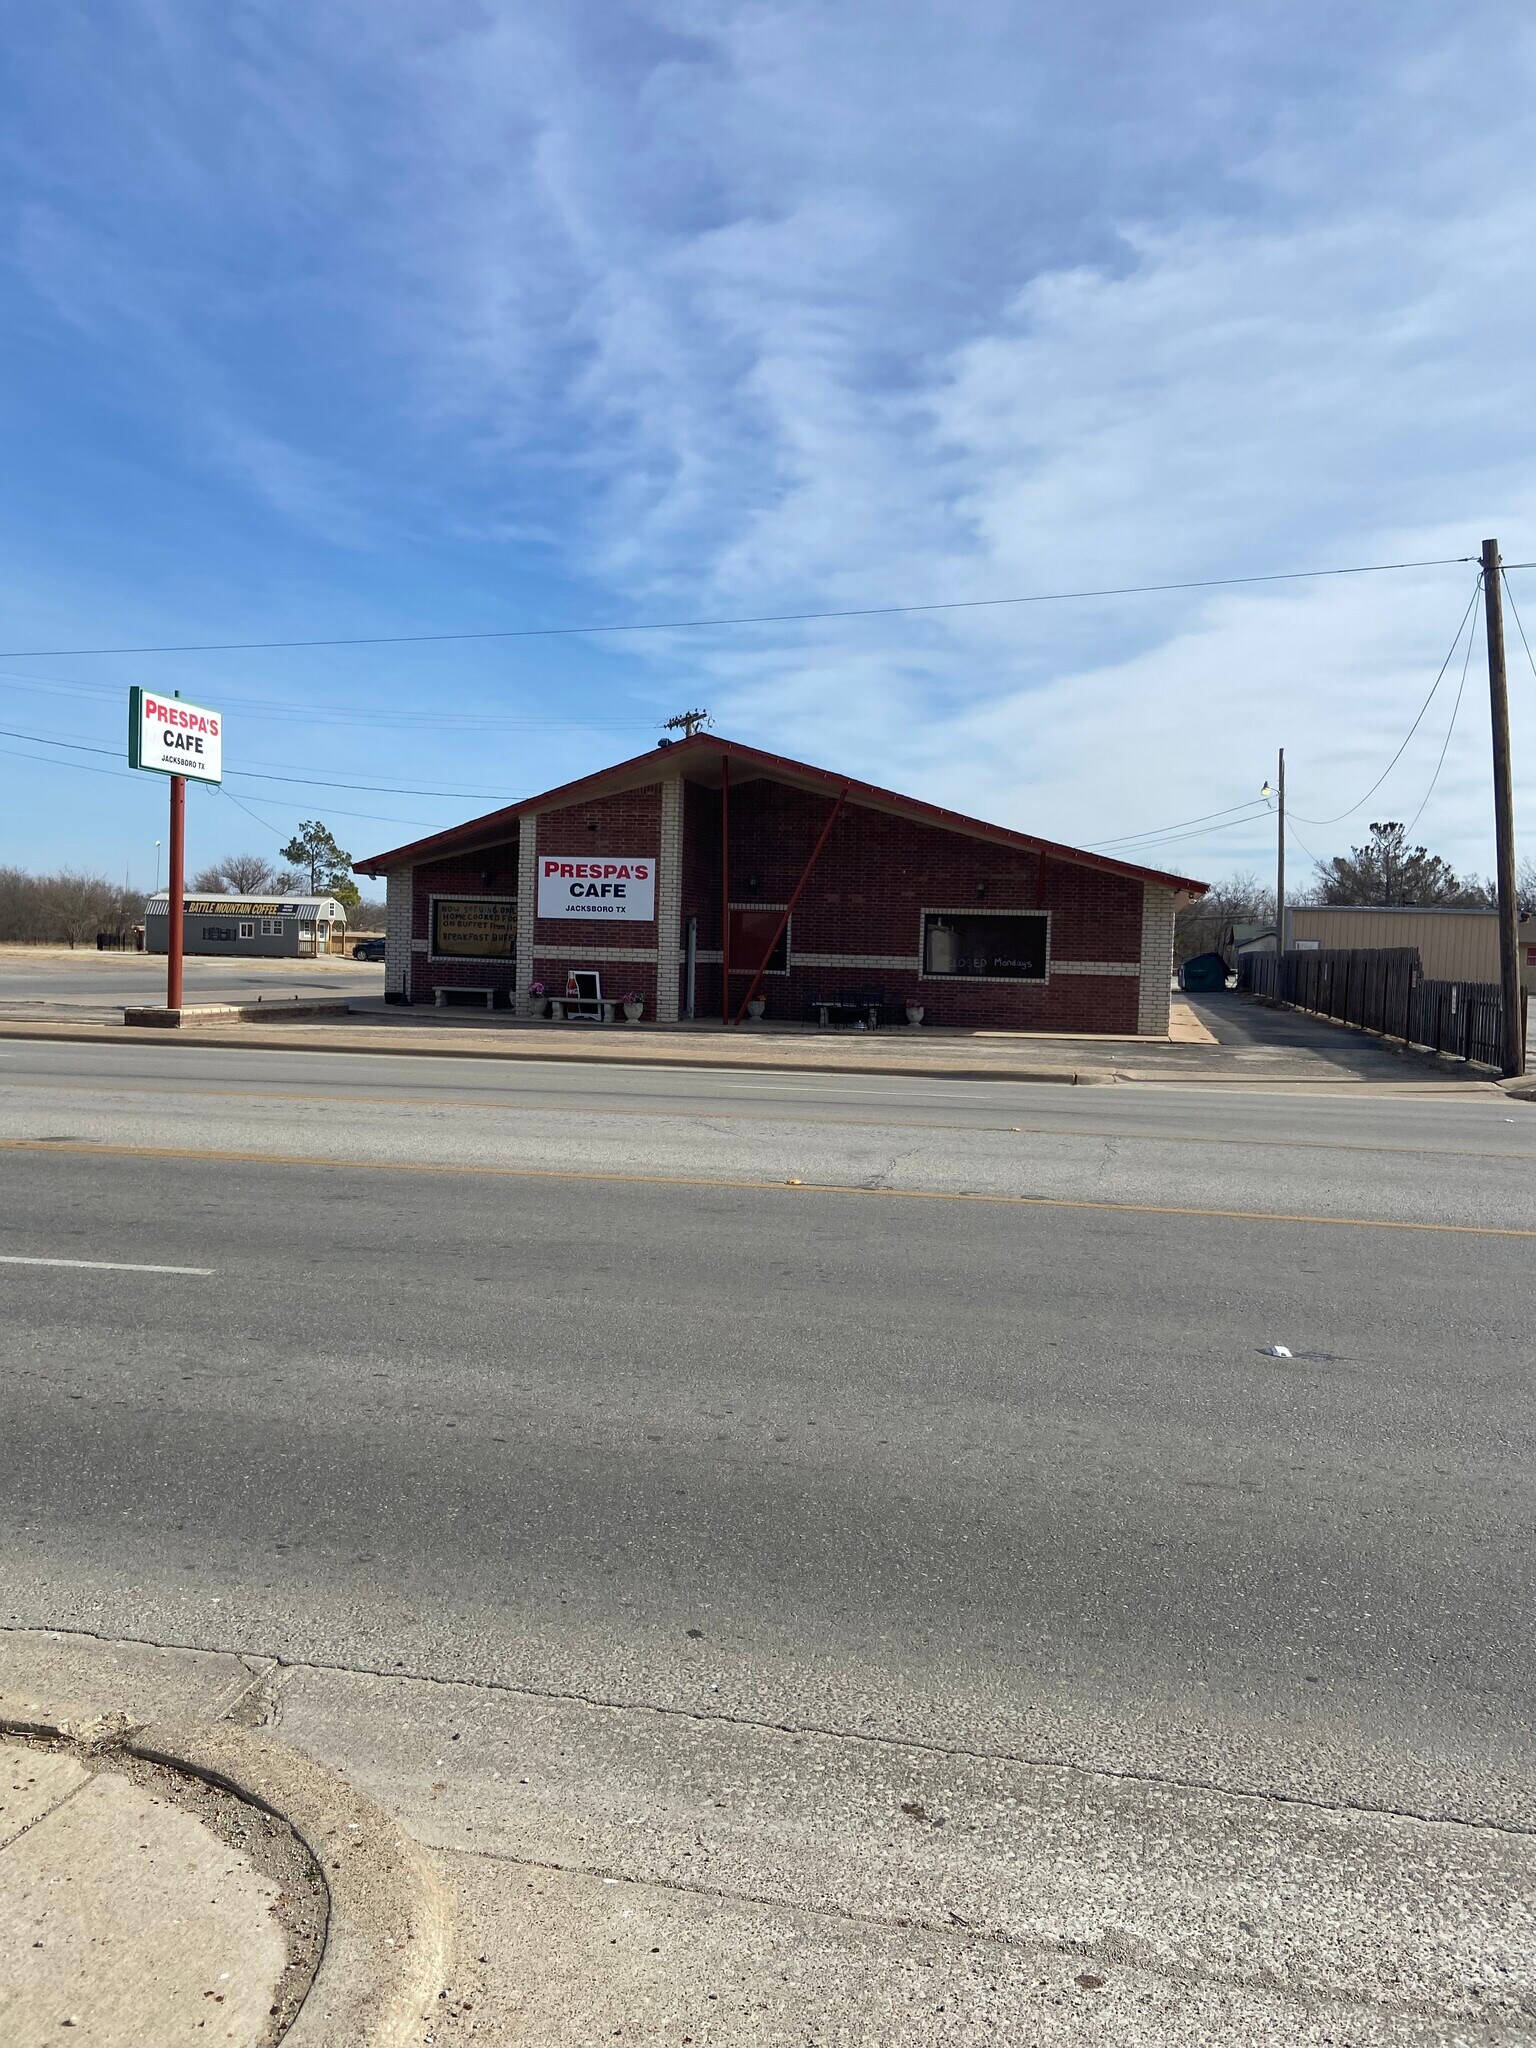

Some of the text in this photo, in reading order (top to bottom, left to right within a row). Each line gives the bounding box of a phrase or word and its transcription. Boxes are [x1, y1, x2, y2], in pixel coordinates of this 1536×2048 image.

[145, 698, 219, 736] PRESPA'S
[163, 729, 204, 754] CAFE
[161, 754, 205, 770] JACKSBORO TX
[544, 861, 648, 880] PRESPA'S
[569, 882, 627, 898] CAFE
[188, 902, 214, 913] BATTLE
[214, 903, 251, 914] MOUNTAIN
[251, 904, 279, 915] COFFEE
[565, 905, 614, 913] JACKSBORO
[994, 957, 1033, 969] Mondays
